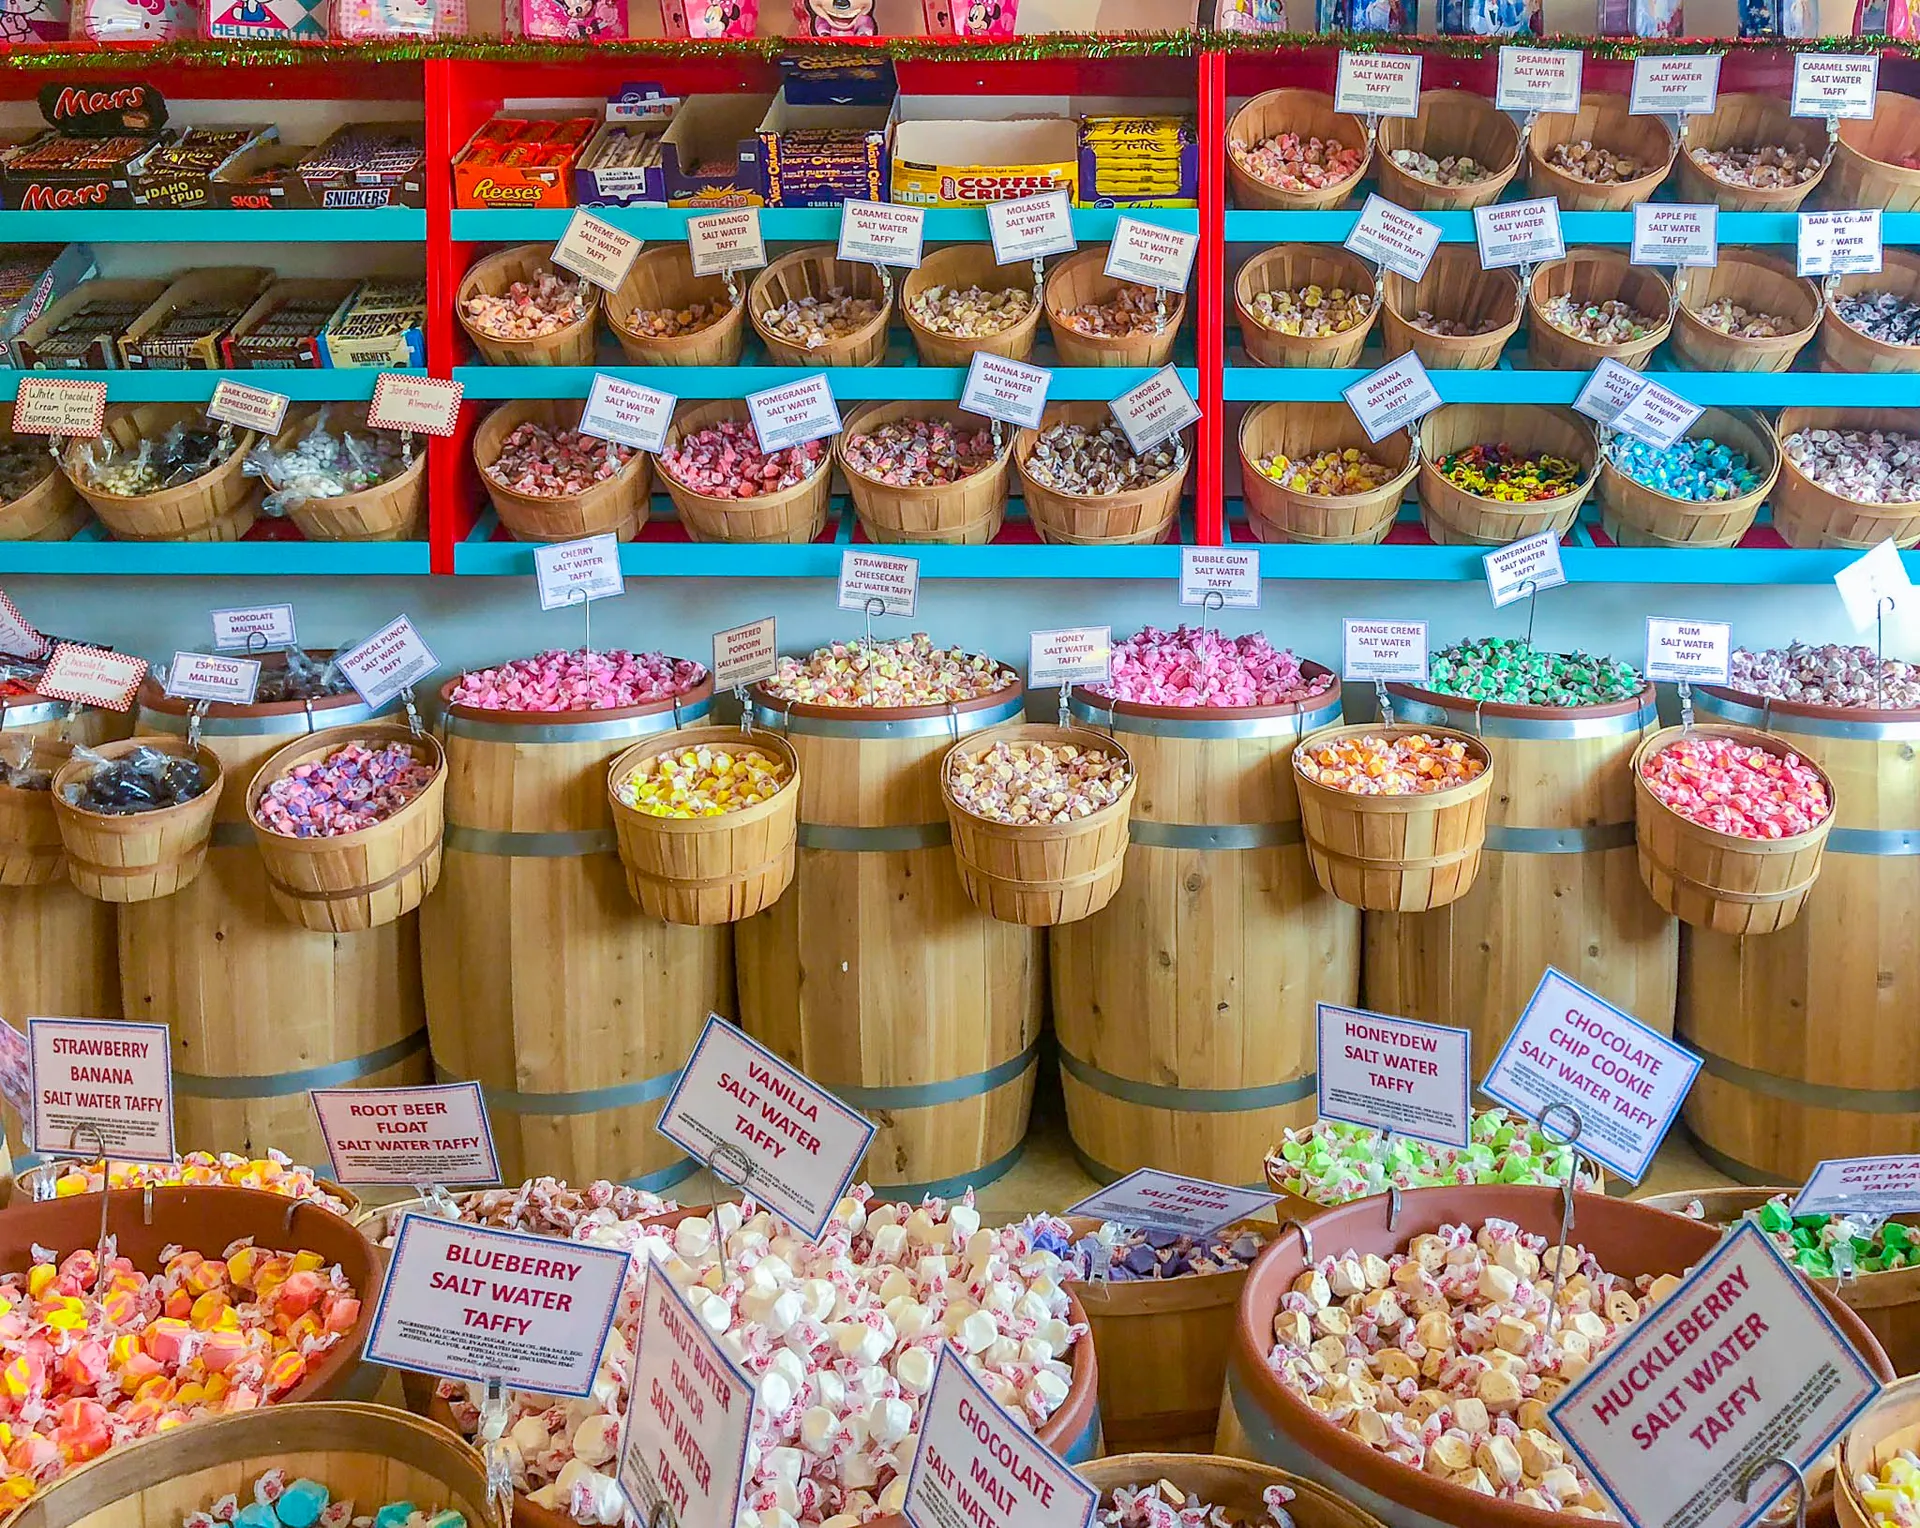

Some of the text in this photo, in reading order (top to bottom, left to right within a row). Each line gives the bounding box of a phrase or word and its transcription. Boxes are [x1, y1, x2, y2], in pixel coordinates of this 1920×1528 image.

[212, 24, 270, 38] HELLO
[1350, 59, 1410, 70] MAPLE BACON
[1517, 55, 1565, 65] SPEARMINT
[1662, 62, 1692, 70] MAPLE
[1803, 62, 1871, 72] CARAMEL SWIRL
[1353, 71, 1403, 81] SALT WATER
[1366, 84, 1390, 92] TAFFY
[53, 86, 144, 119] Mars
[768, 134, 779, 175] CRUMBLE
[957, 176, 1053, 188] COFFEE
[21, 183, 109, 210] Mars
[145, 182, 188, 199] IDAHO
[171, 189, 204, 204] SPUD
[325, 190, 388, 206] SNICKERS
[957, 188, 1034, 200] CRISP
[231, 196, 272, 208] SKOR
[1007, 201, 1050, 215] MOLASSES
[852, 208, 918, 223] CARAMEL CORN
[1489, 206, 1545, 221] CHERRY COLA
[1655, 212, 1680, 220] APPLE
[698, 214, 750, 229] CHILI MANGO
[1381, 210, 1422, 235] CHICKEN &
[1648, 224, 1668, 232] SALT
[583, 220, 630, 247] XTREME HOT
[1130, 226, 1184, 245] PUMPKIN PIE
[1382, 222, 1414, 242] WAFFLE
[1662, 236, 1687, 244] TAFFY
[350, 352, 391, 362] HERSHEY'S
[983, 362, 1042, 384] BANANA SPLIT
[1607, 371, 1630, 386] SASSY
[389, 384, 420, 396] Jordan
[1367, 372, 1401, 394] BANANA
[29, 388, 94, 402] White Chocolate
[222, 387, 240, 397] DARK
[608, 384, 660, 404] NEAPOLITAN
[757, 382, 822, 407] POMEGRANATE
[1129, 381, 1161, 404] S'MORES
[34, 403, 93, 413] Cream Covered
[220, 397, 252, 410] ESPRESSO
[1647, 389, 1694, 416] PASSION FRUIT
[24, 412, 90, 425] Espresso Beans
[561, 547, 593, 559] CHERRY
[1494, 539, 1548, 564] WATERMELON
[854, 558, 908, 572] STRAWBERRY
[1192, 556, 1248, 564] BUBBLE GUM
[855, 571, 904, 583] CHEESECAKE
[1195, 567, 1245, 576] SALT WATER
[845, 580, 912, 595] SALT WATER TAFFY
[229, 613, 274, 622] CHOCOLATE
[231, 624, 274, 633] MALTBALLS
[727, 627, 762, 643] BUTTERED
[1351, 626, 1420, 635] ORANGE CREME
[1678, 627, 1700, 635] RUM
[1055, 634, 1085, 643] HONEY
[1661, 638, 1714, 650] SALT WATER
[344, 623, 408, 670] TROPICAL PUNCH
[728, 639, 760, 654] POPCORN
[1676, 651, 1701, 660] TAFFY
[189, 673, 238, 686] MALTBALLS
[1345, 1022, 1437, 1053] HONEYDEW
[1565, 1008, 1663, 1076] CHOCOLATE
[53, 1038, 148, 1059] STRAWBERRY
[1345, 1046, 1438, 1077] SALT WATER
[1549, 1028, 1590, 1058] CHIP
[1591, 1049, 1655, 1100] COOKIE
[71, 1066, 133, 1085] BANANA
[1368, 1072, 1415, 1095] TAFFY
[1518, 1040, 1558, 1070] SALT
[1559, 1065, 1613, 1106] WATER
[1614, 1097, 1658, 1132] TAFFY
[748, 1062, 819, 1123] VANILLA
[43, 1090, 163, 1113] SALT WATER TAFFY
[350, 1102, 448, 1117] ROOT BEER
[716, 1072, 759, 1109] SALT
[760, 1096, 821, 1155] WATER
[377, 1121, 428, 1134] FLOAT
[337, 1137, 480, 1151] SALT WATER TAFFY
[735, 1114, 787, 1160] TAFFY
[1842, 1163, 1904, 1174] GREEN
[1839, 1174, 1885, 1184] SALT
[1862, 1182, 1916, 1191] TAFFY
[1138, 1189, 1229, 1210] SALT WATER
[1176, 1184, 1230, 1200] GRAPE
[1147, 1201, 1194, 1214] TAFFY
[446, 1244, 582, 1282] BLUEBERRY
[430, 1272, 573, 1312] SALT WATER
[463, 1308, 532, 1336] TAFFY
[1591, 1265, 1749, 1426] HUCKLEBERRY
[659, 1296, 731, 1414] PEANUT BUTTER
[1632, 1387, 1687, 1450] SALT
[1682, 1312, 1770, 1394] WATER
[670, 1358, 704, 1424] FLAVOR
[1690, 1376, 1762, 1450] TAFFY
[651, 1377, 711, 1496] SALT WATER
[959, 1398, 1054, 1509] CHOCOLATE
[659, 1448, 689, 1519] TAFFY
[925, 1444, 956, 1490] SALT
[956, 1482, 1000, 1528] WATE
[970, 1456, 1018, 1516] MALT
